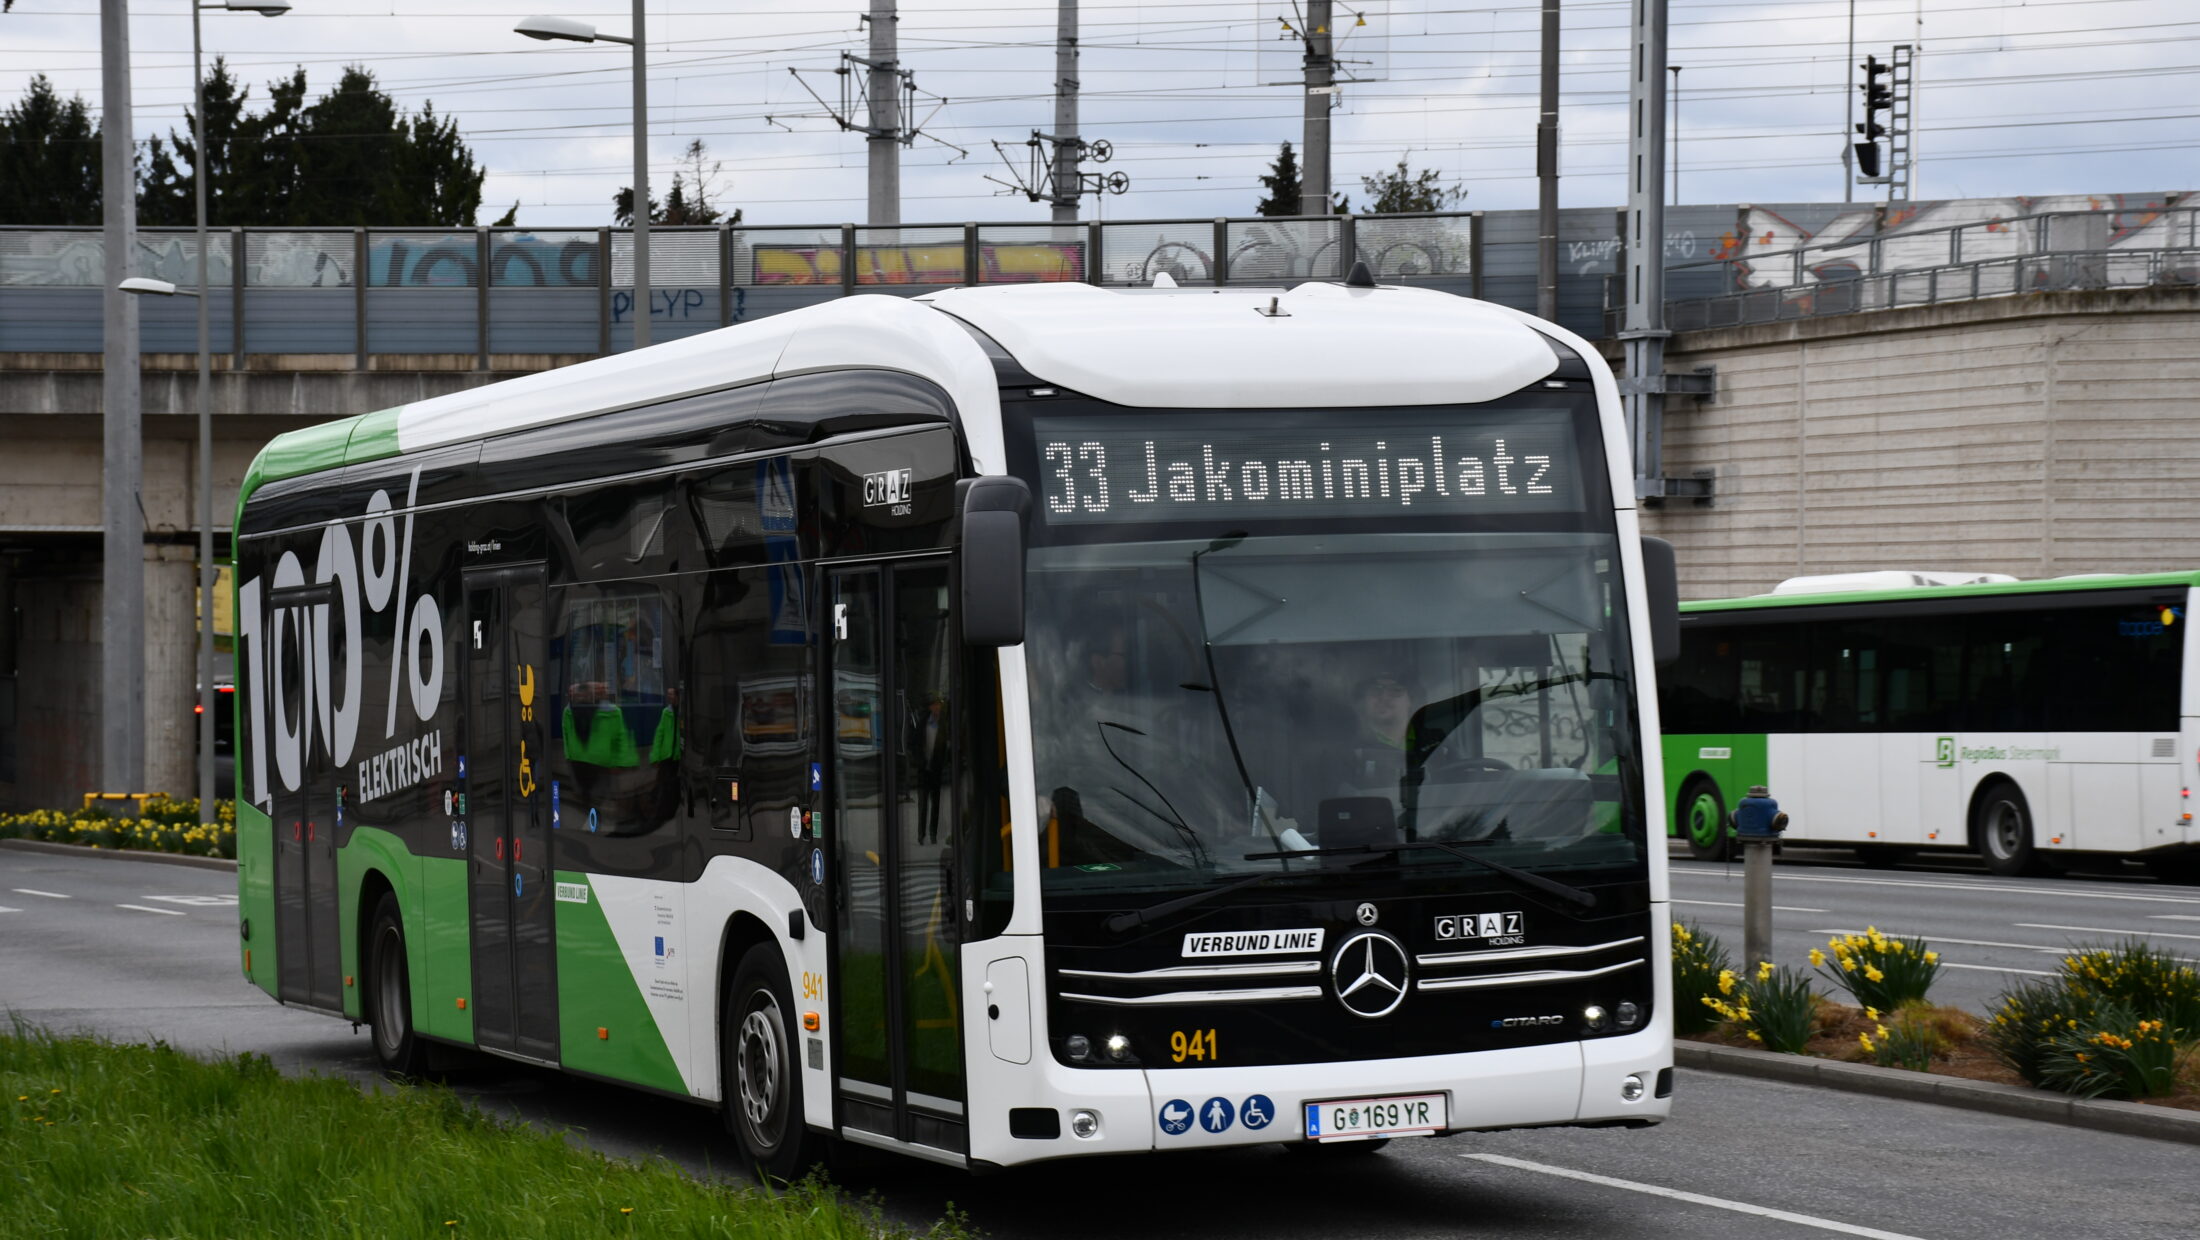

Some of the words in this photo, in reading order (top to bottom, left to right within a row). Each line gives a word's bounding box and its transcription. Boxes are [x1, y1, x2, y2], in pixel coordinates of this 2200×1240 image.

[865, 472, 910, 503] GRAZ
[1046, 442, 1109, 512] 33
[1129, 436, 1552, 505] Jakominiplatz
[891, 504, 911, 516] HOLDING
[239, 463, 443, 806] 100%
[359, 729, 442, 804] ELEKTRISCH
[1437, 914, 1520, 937] GRAZ
[1489, 936, 1525, 945] HOLDING
[1190, 934, 1270, 953] VERBUND
[1274, 932, 1317, 949] LINIE
[803, 971, 823, 1001] 941
[1171, 1029, 1217, 1063] 941
[1334, 1107, 1346, 1131] G
[1363, 1104, 1399, 1128] 169
[1404, 1101, 1429, 1125] YR
